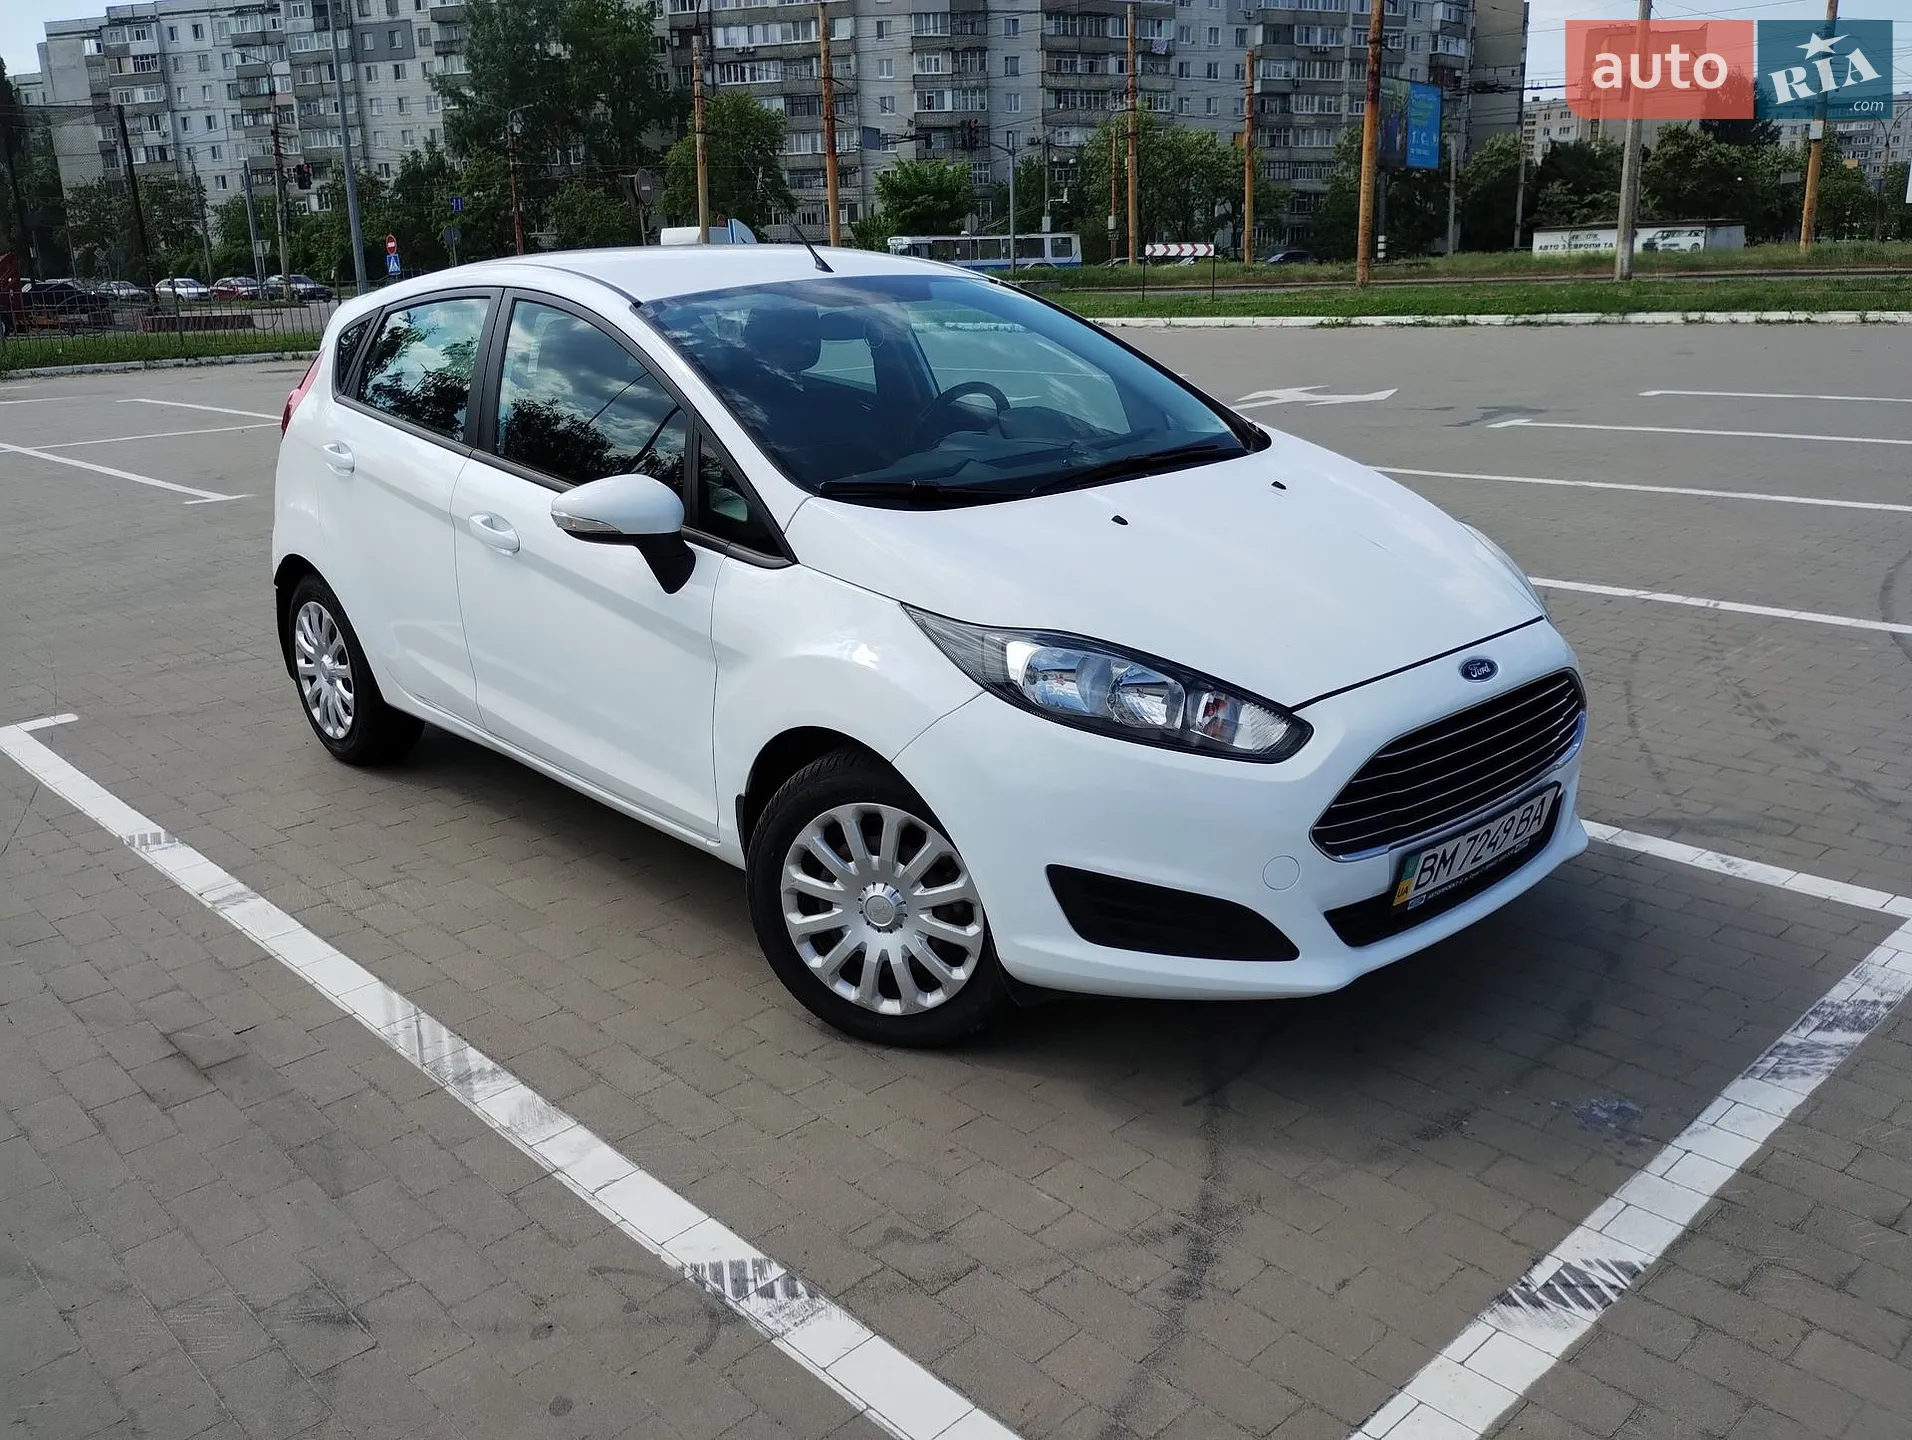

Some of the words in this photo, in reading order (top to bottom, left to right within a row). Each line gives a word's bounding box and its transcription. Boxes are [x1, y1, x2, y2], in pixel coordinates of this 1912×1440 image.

[1467, 662, 1491, 678] Ford
[1413, 841, 1461, 892] BM
[1458, 815, 1516, 871] 7249
[1513, 796, 1547, 841] BA
